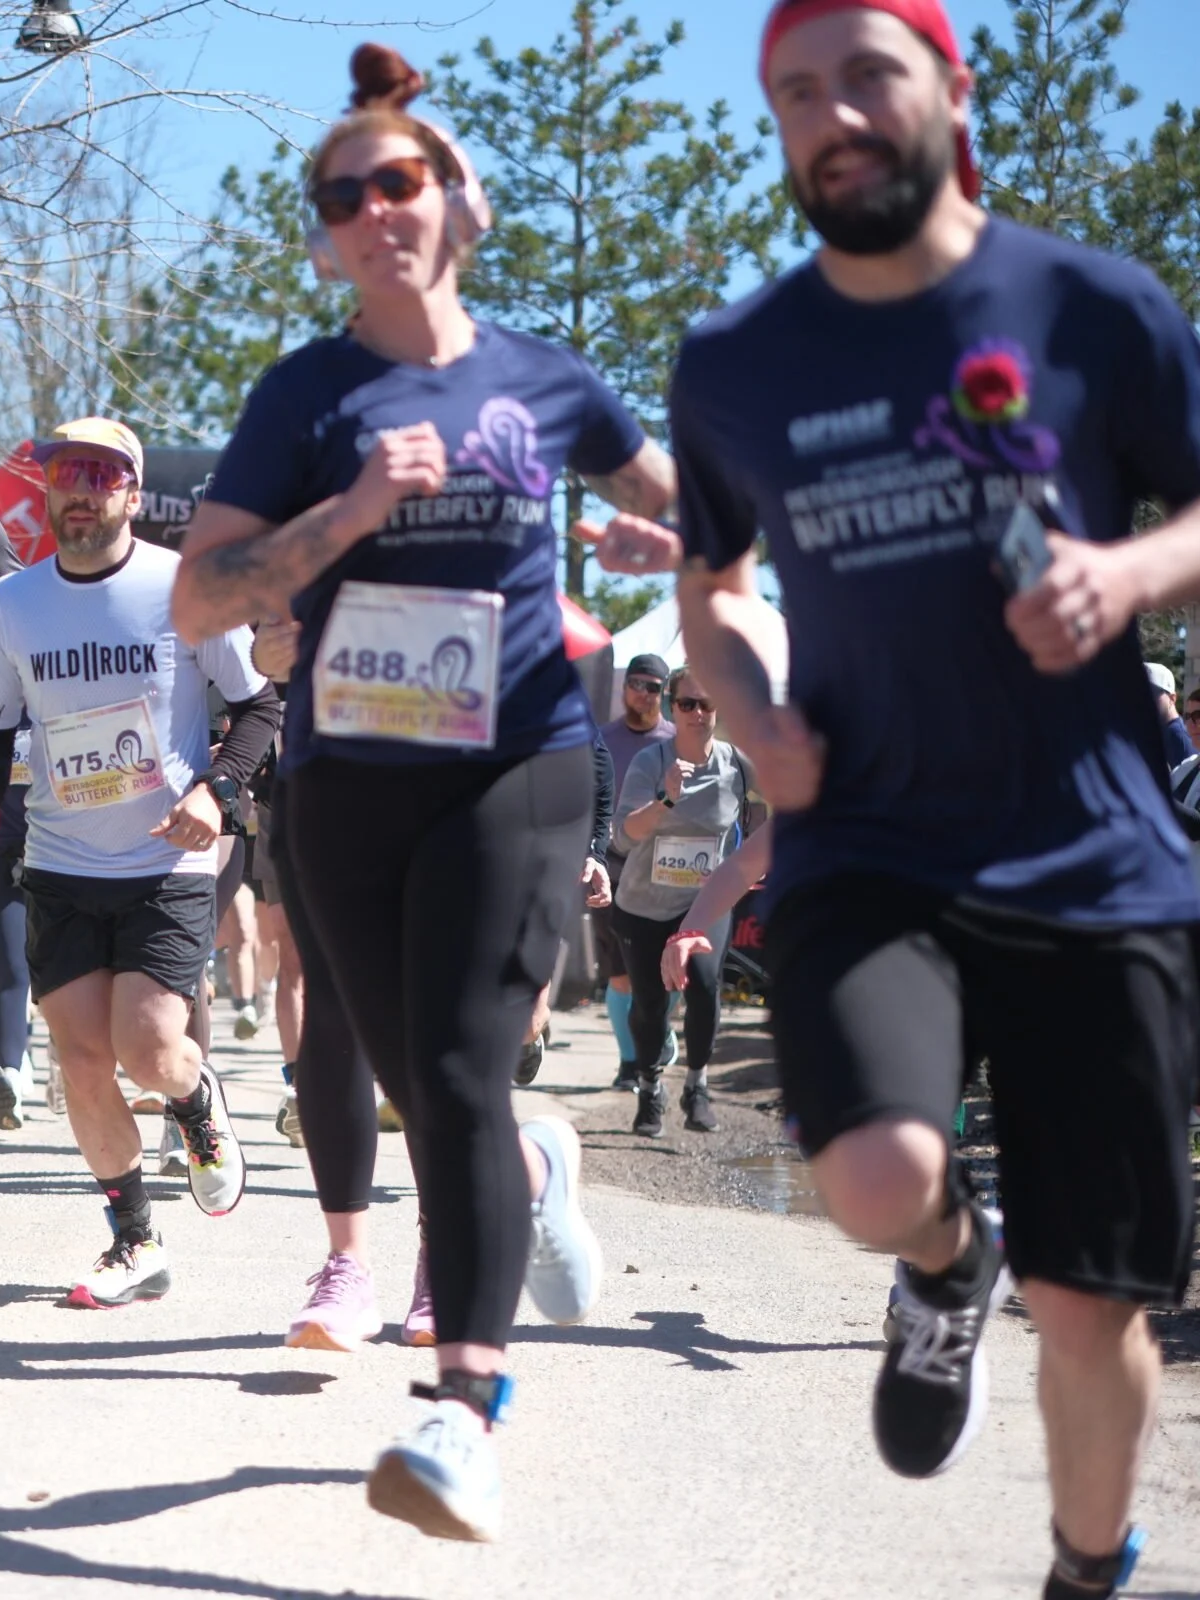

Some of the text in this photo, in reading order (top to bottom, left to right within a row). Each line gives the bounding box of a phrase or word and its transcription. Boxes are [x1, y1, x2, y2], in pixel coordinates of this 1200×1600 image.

[133, 489, 192, 522] PLITS
[502, 496, 546, 526] RUN
[791, 480, 973, 551] BUTTERFLY
[327, 647, 407, 683] 488
[56, 751, 103, 778] 175
[63, 774, 124, 793] PETERBOROUGH
[64, 773, 158, 804] BUTTERFLY RUN
[657, 856, 687, 869] 429
